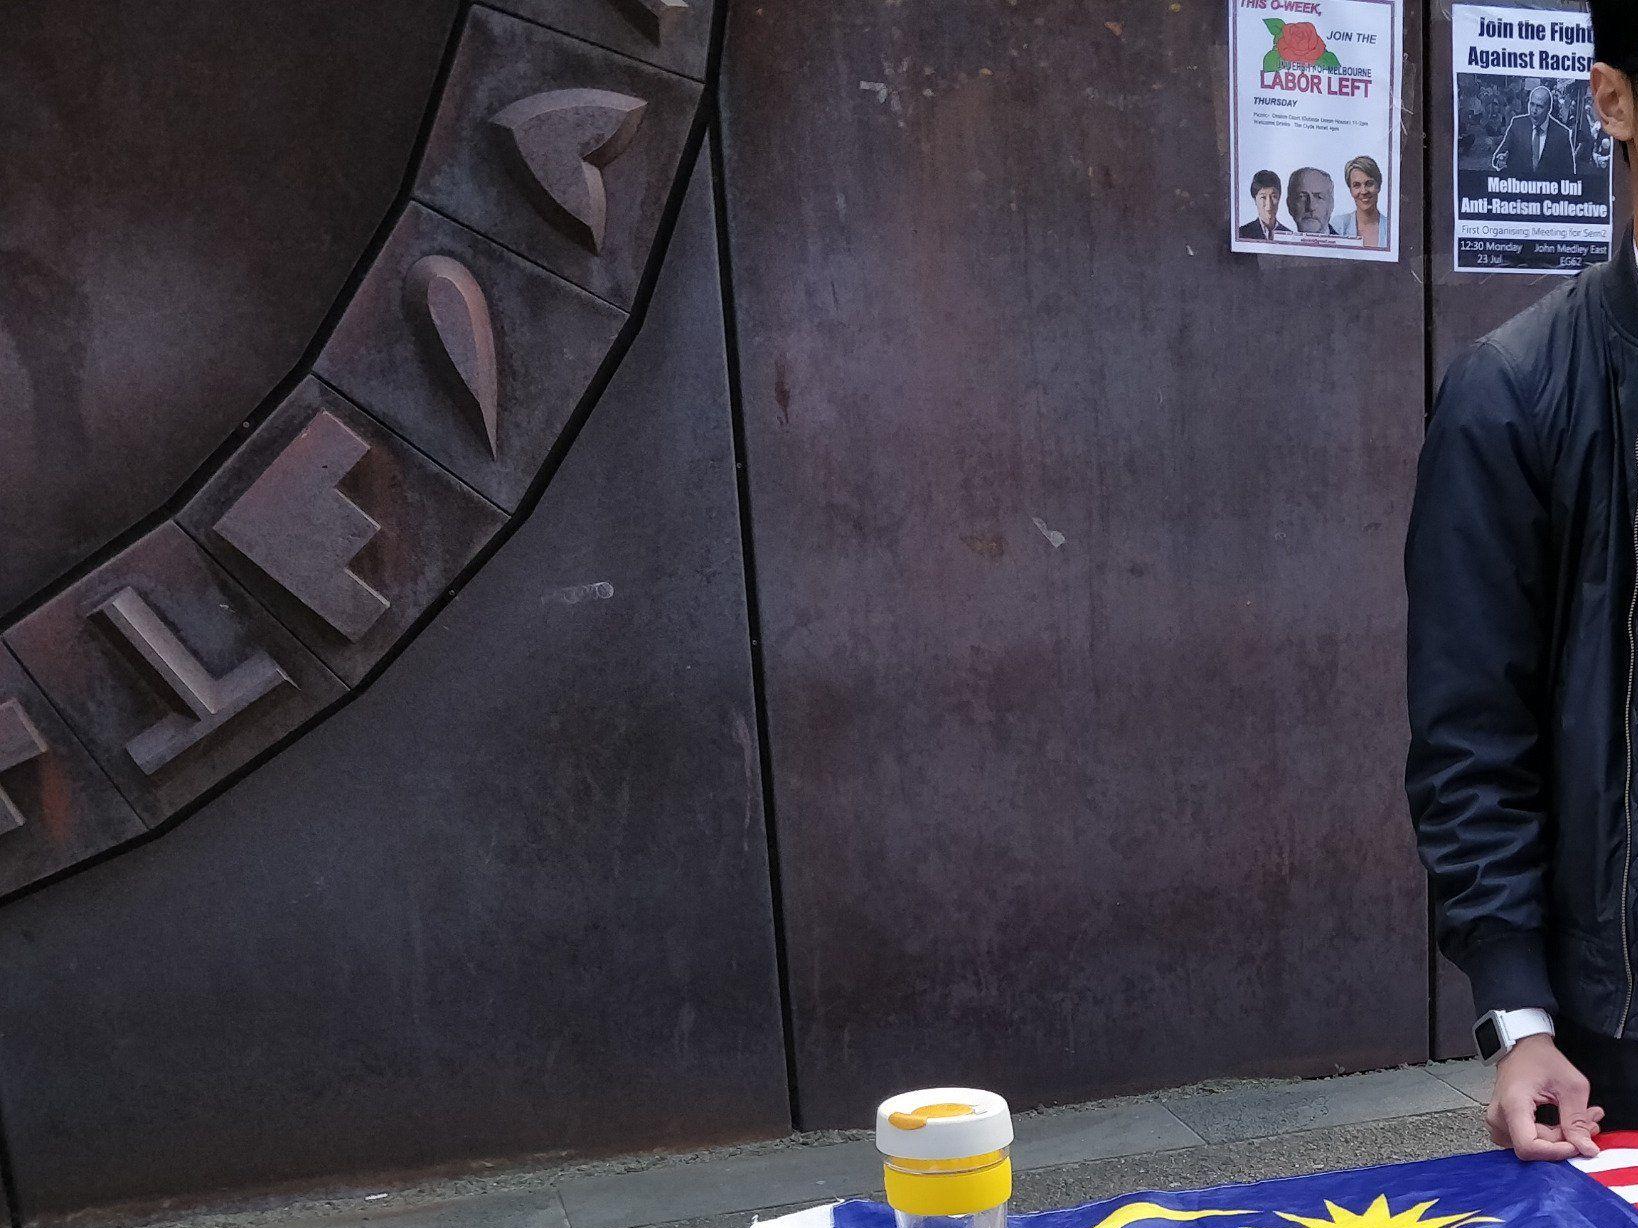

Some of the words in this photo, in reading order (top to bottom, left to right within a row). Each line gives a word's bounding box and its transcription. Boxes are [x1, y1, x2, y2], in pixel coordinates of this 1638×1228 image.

[1241, 0, 1267, 9] THIS
[1326, 30, 1353, 43] JOIN
[1356, 32, 1378, 44] THE
[1478, 17, 1514, 39] Join
[1518, 20, 1546, 41] the
[1550, 22, 1594, 45] Fight
[1467, 46, 1535, 69] Against
[1327, 65, 1372, 78] MELBOURNE
[1260, 70, 1323, 94] LABOR
[1327, 77, 1373, 98] LEFT
[1253, 97, 1298, 108] THURSDAY
[1487, 176, 1559, 196] Melbourne
[1560, 179, 1582, 196] Uni
[1461, 197, 1541, 216] Anti-Racism
[1542, 200, 1608, 218] Collective
[1461, 225, 1480, 235] First
[1482, 225, 1529, 238] Organising
[1460, 240, 1484, 251] 12:30
[1485, 242, 1523, 254] Monday
[1534, 243, 1556, 253] John
[1557, 244, 1588, 256] Medley
[1590, 246, 1608, 255] East
[1477, 254, 1488, 264] 23
